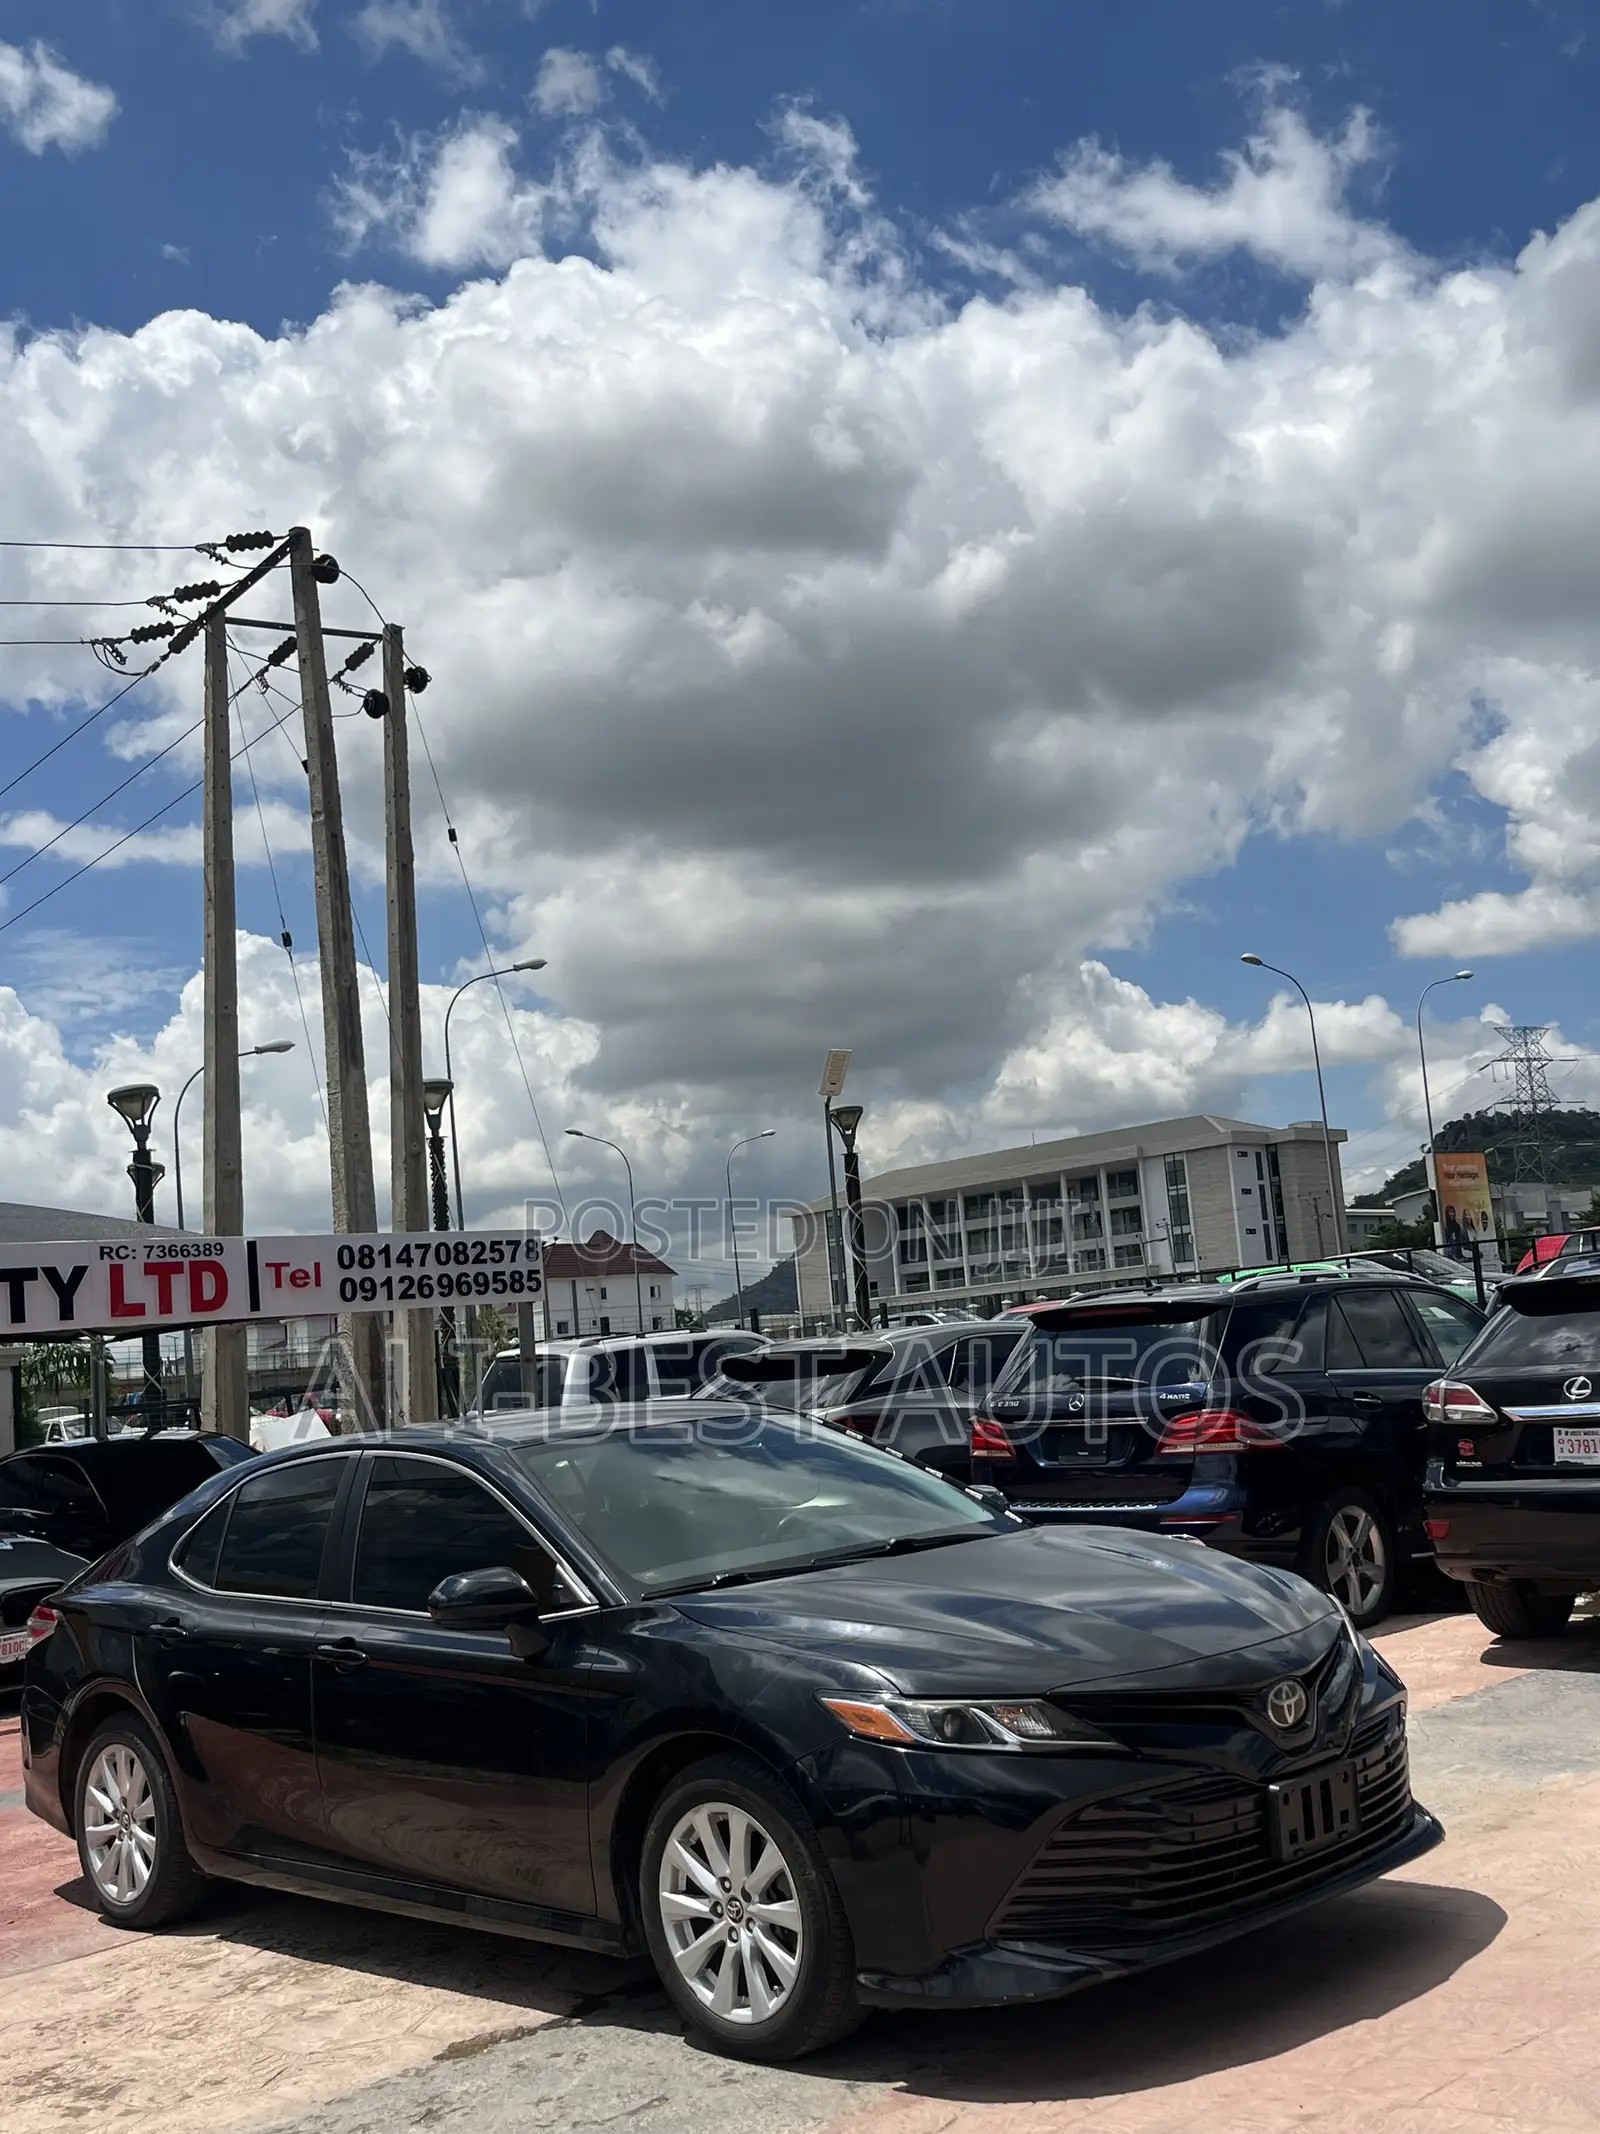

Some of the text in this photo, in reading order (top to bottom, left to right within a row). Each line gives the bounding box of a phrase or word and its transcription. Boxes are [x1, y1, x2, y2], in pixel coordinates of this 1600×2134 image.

[99, 1242, 224, 1260] RC: 7366389
[337, 1239, 540, 1270] 08147082578
[265, 1262, 322, 1289] Tel
[339, 1269, 542, 1302] 09126969585
[0, 1259, 229, 1324] TY LTD
[1566, 1438, 1600, 1454] 3781
